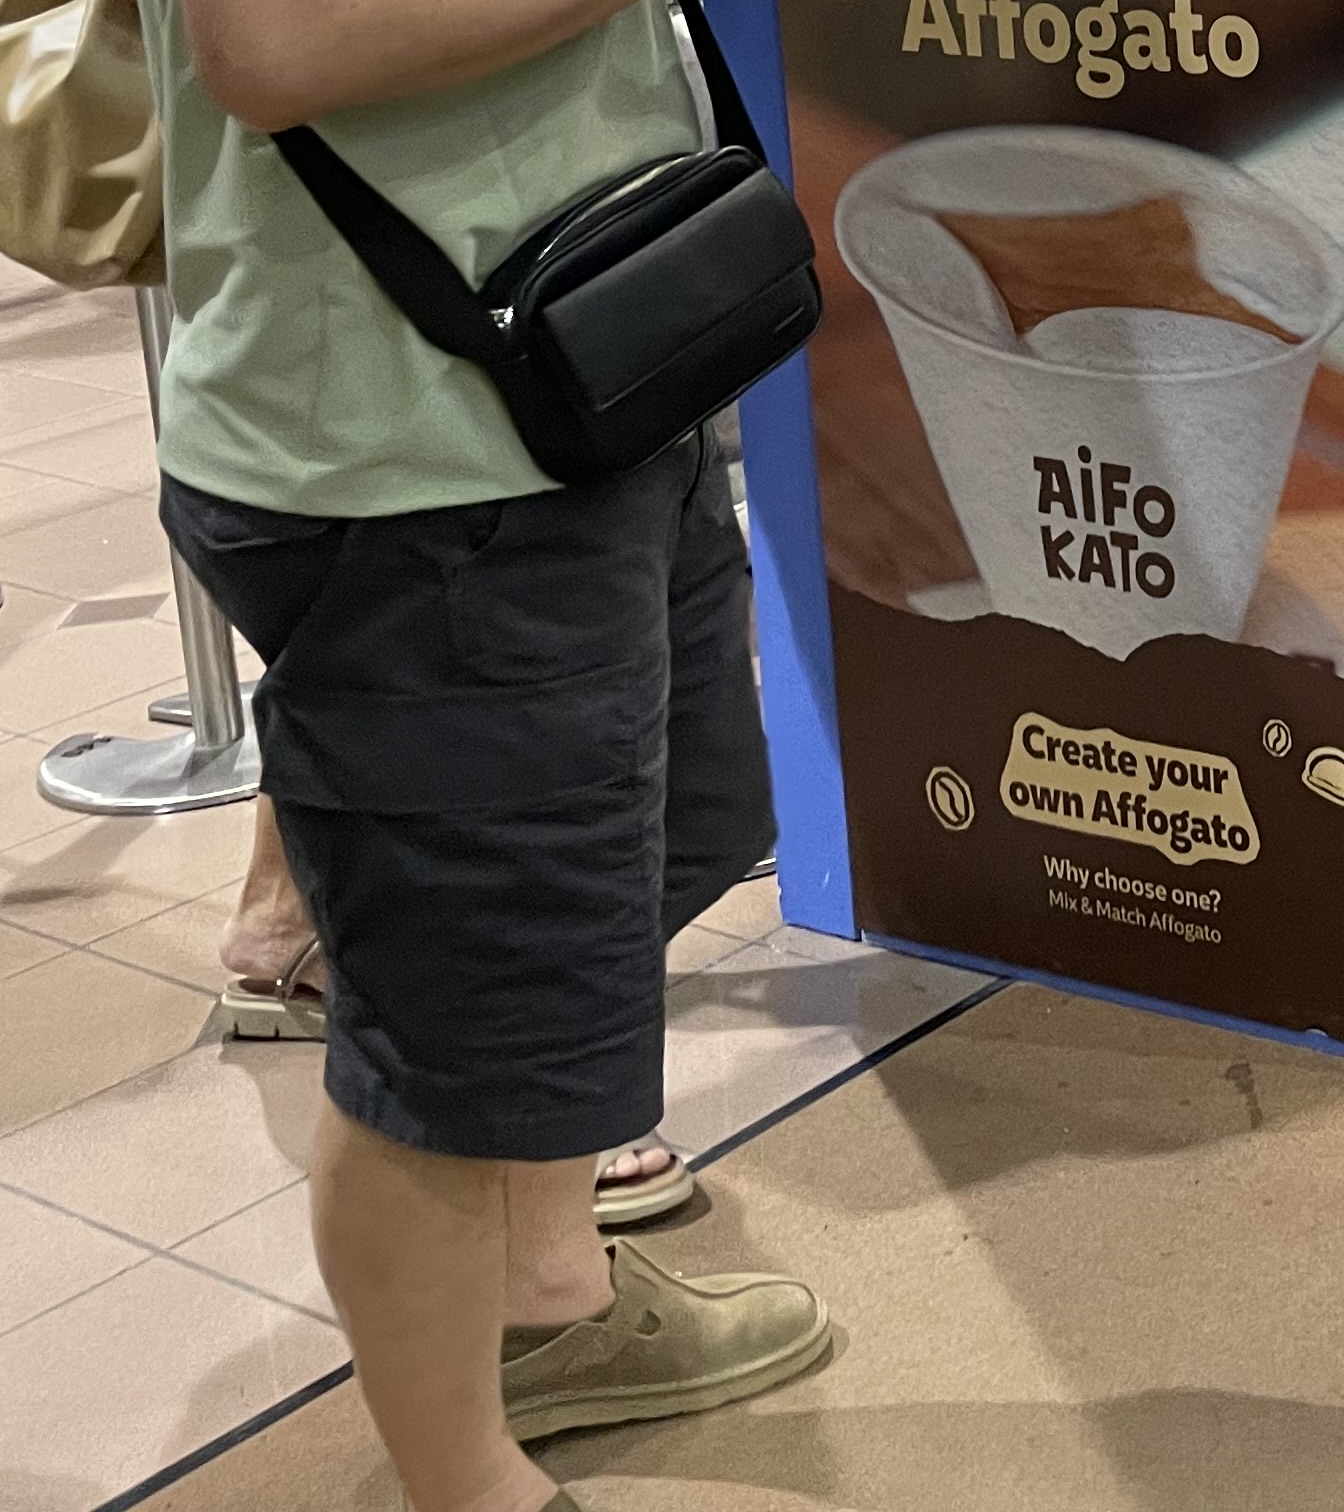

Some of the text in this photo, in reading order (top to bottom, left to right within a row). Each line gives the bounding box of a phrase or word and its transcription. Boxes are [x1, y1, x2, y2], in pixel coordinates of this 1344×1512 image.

[1040, 525, 1175, 598] KATO
[1022, 723, 1228, 795] Create your
[1008, 781, 1250, 854] own Affogato
[1043, 854, 1221, 912] Why choose one?
[1049, 888, 1222, 944] Mix & Match Affogato
